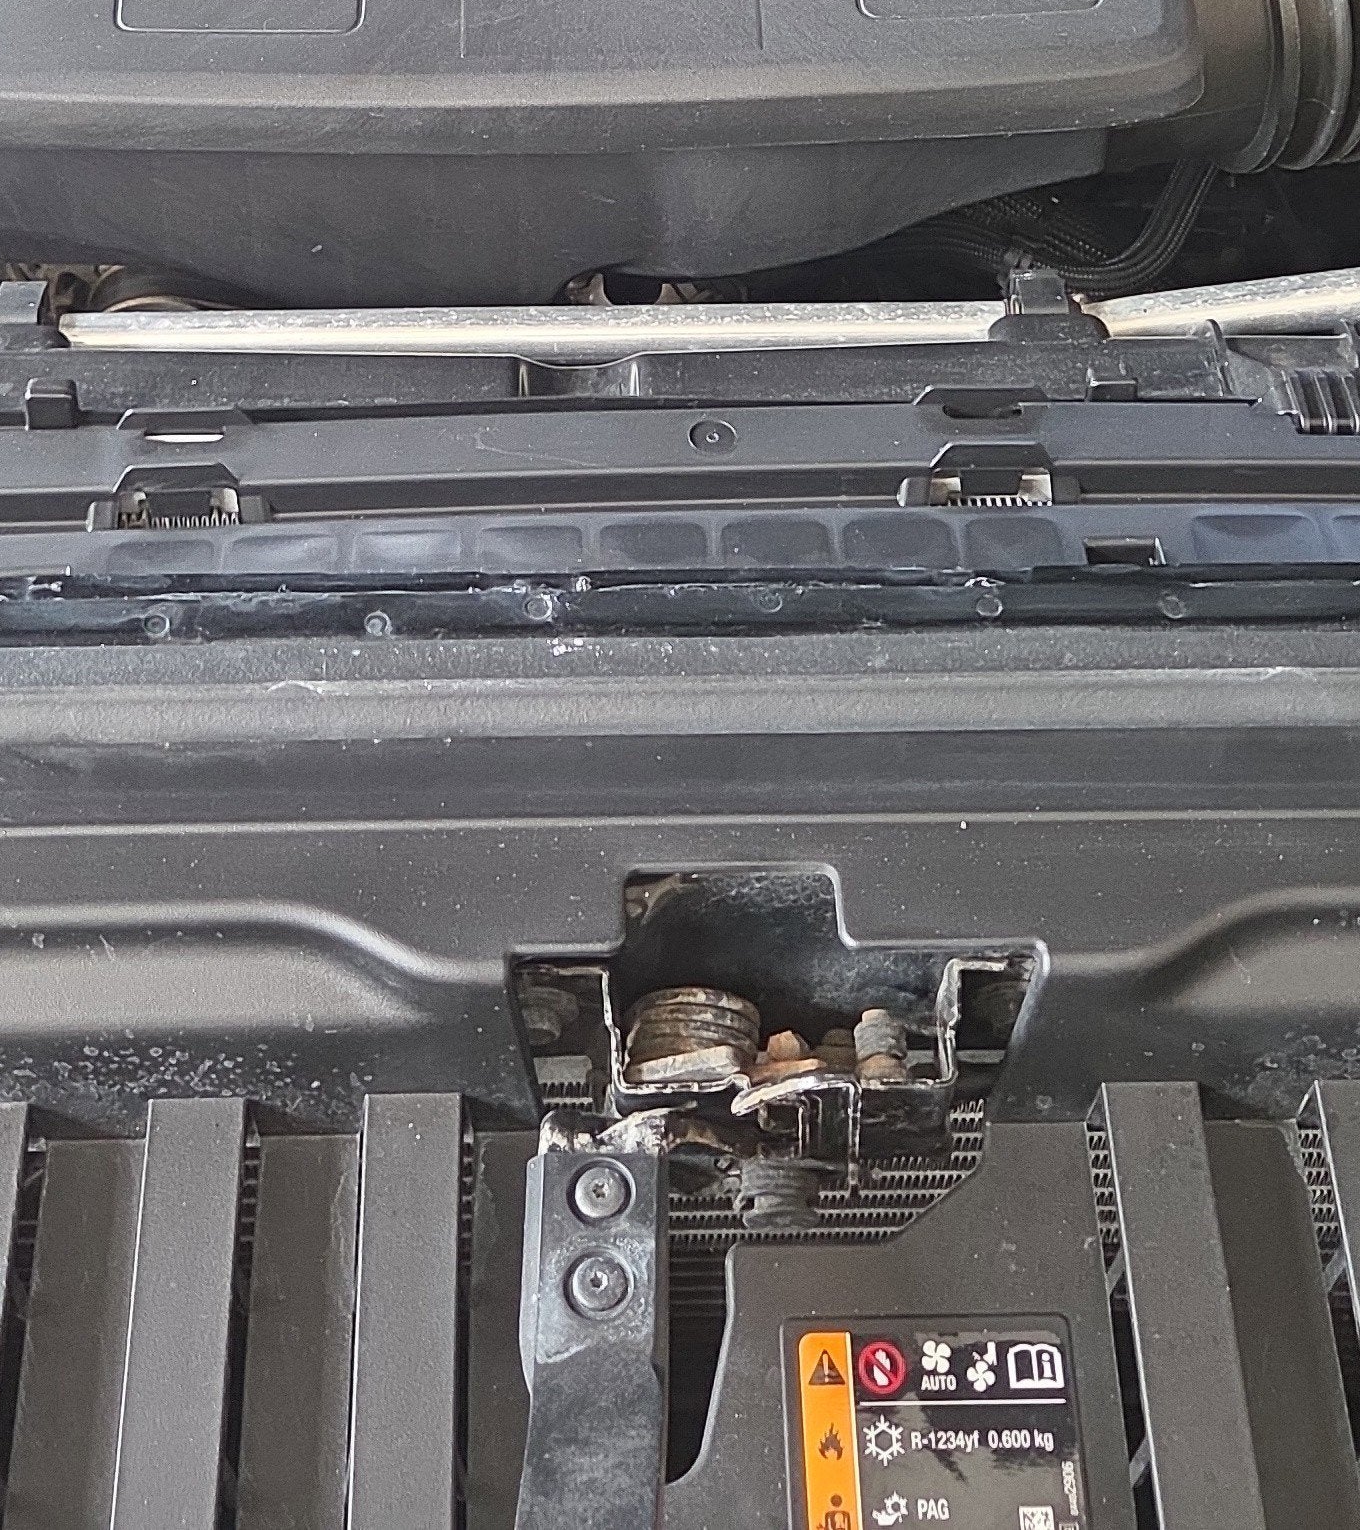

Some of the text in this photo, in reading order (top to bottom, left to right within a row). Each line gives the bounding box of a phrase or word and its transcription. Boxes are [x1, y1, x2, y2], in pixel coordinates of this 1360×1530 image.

[920, 1374, 957, 1391] AUTO
[911, 1427, 1054, 1453] R-1234yf 0.600 kg
[917, 1498, 949, 1520] PAG
